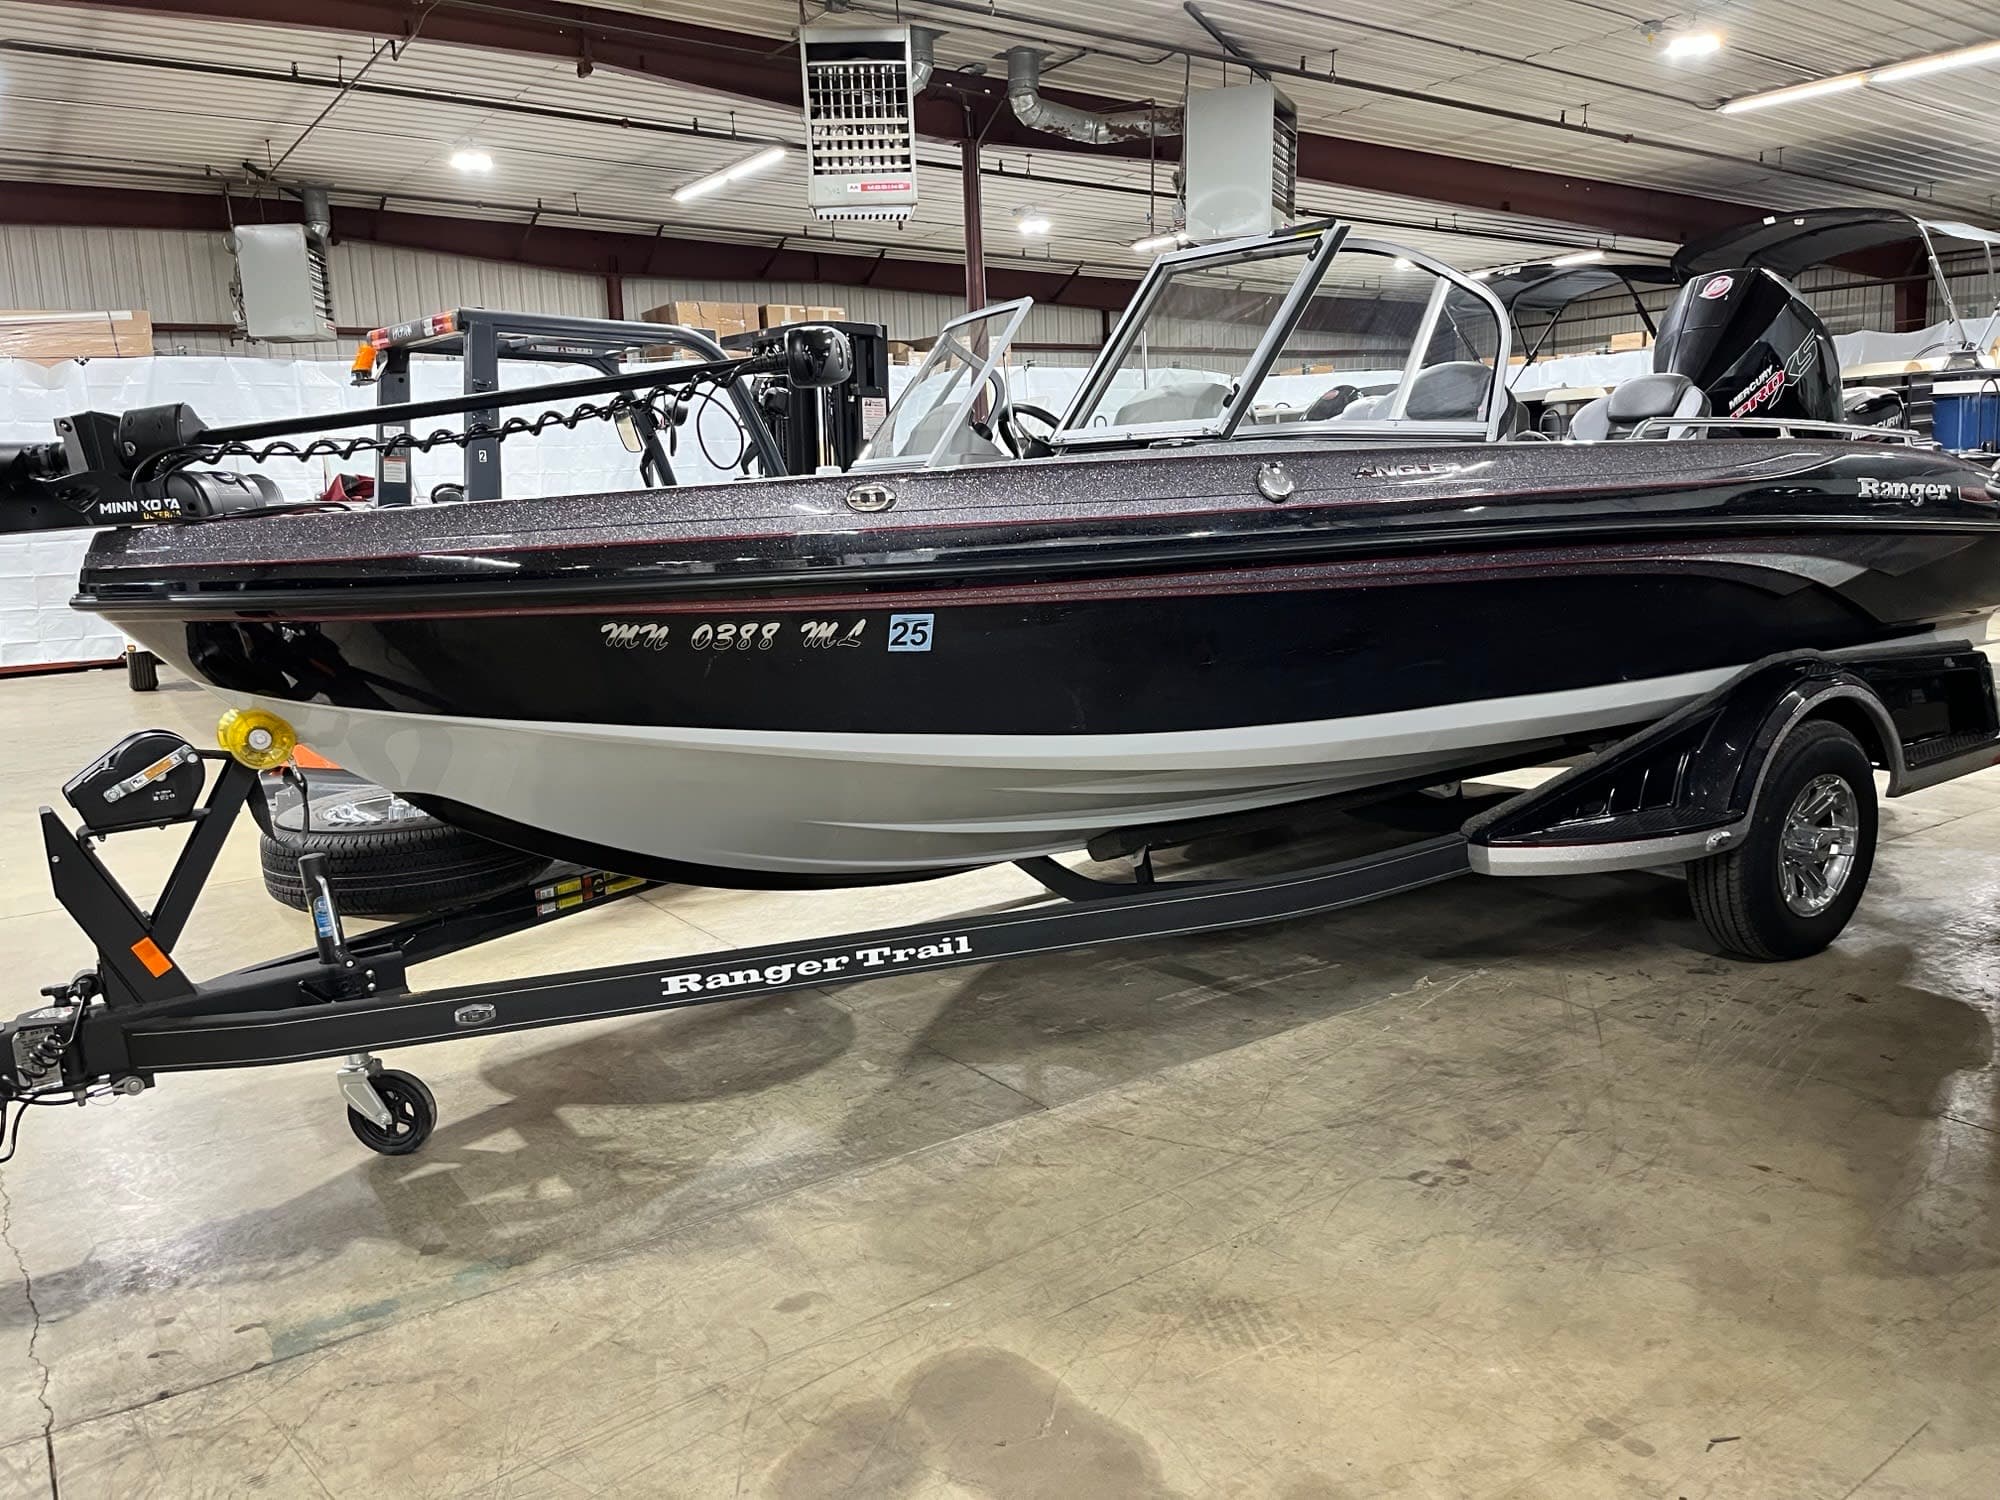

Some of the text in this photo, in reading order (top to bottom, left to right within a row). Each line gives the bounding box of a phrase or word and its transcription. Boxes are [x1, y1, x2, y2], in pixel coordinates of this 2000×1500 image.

[1729, 365, 1773, 410] MERCURY
[100, 501, 138, 514] MINN
[1857, 477, 1952, 507] Ranger
[600, 618, 867, 651] MN 0388 ML
[890, 621, 930, 647] 25
[661, 936, 973, 995] Ranger Trail
